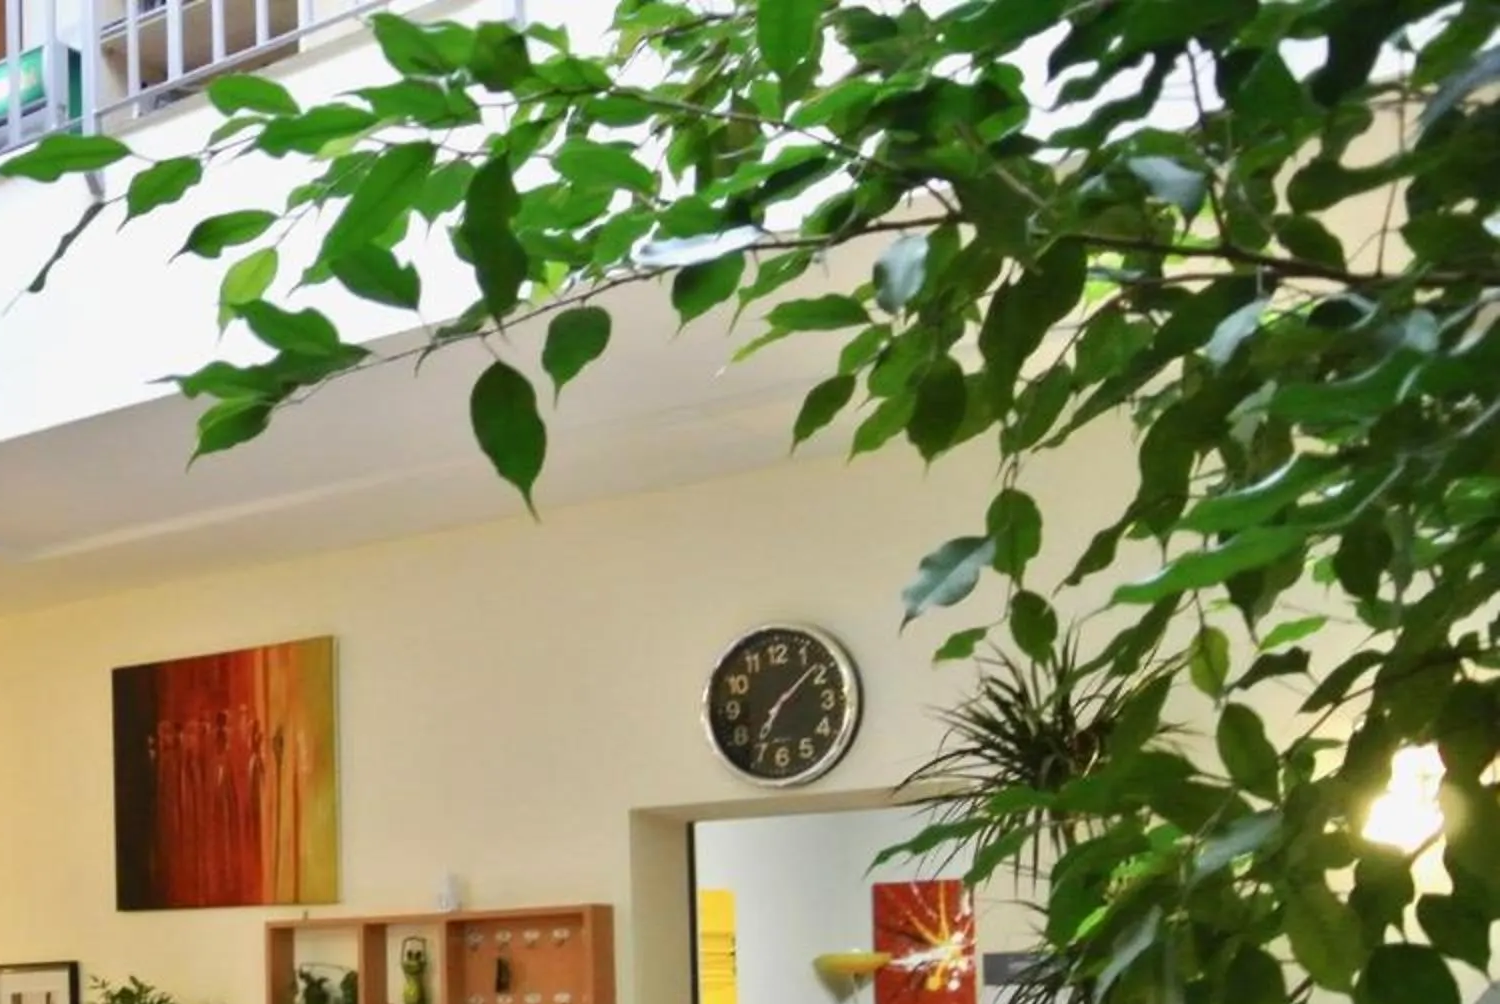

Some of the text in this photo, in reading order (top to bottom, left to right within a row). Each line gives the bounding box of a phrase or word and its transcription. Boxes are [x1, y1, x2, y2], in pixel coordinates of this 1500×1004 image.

[745, 652, 760, 673] 11
[767, 643, 789, 665] 12
[798, 646, 808, 665] 1
[727, 674, 749, 695] 10
[813, 664, 827, 685] 2
[820, 689, 835, 710] 3
[726, 701, 740, 720] 9
[733, 725, 748, 746] 8
[814, 716, 831, 736] 4
[754, 742, 769, 763] 7
[774, 746, 790, 767] 6
[799, 738, 814, 759] 5
